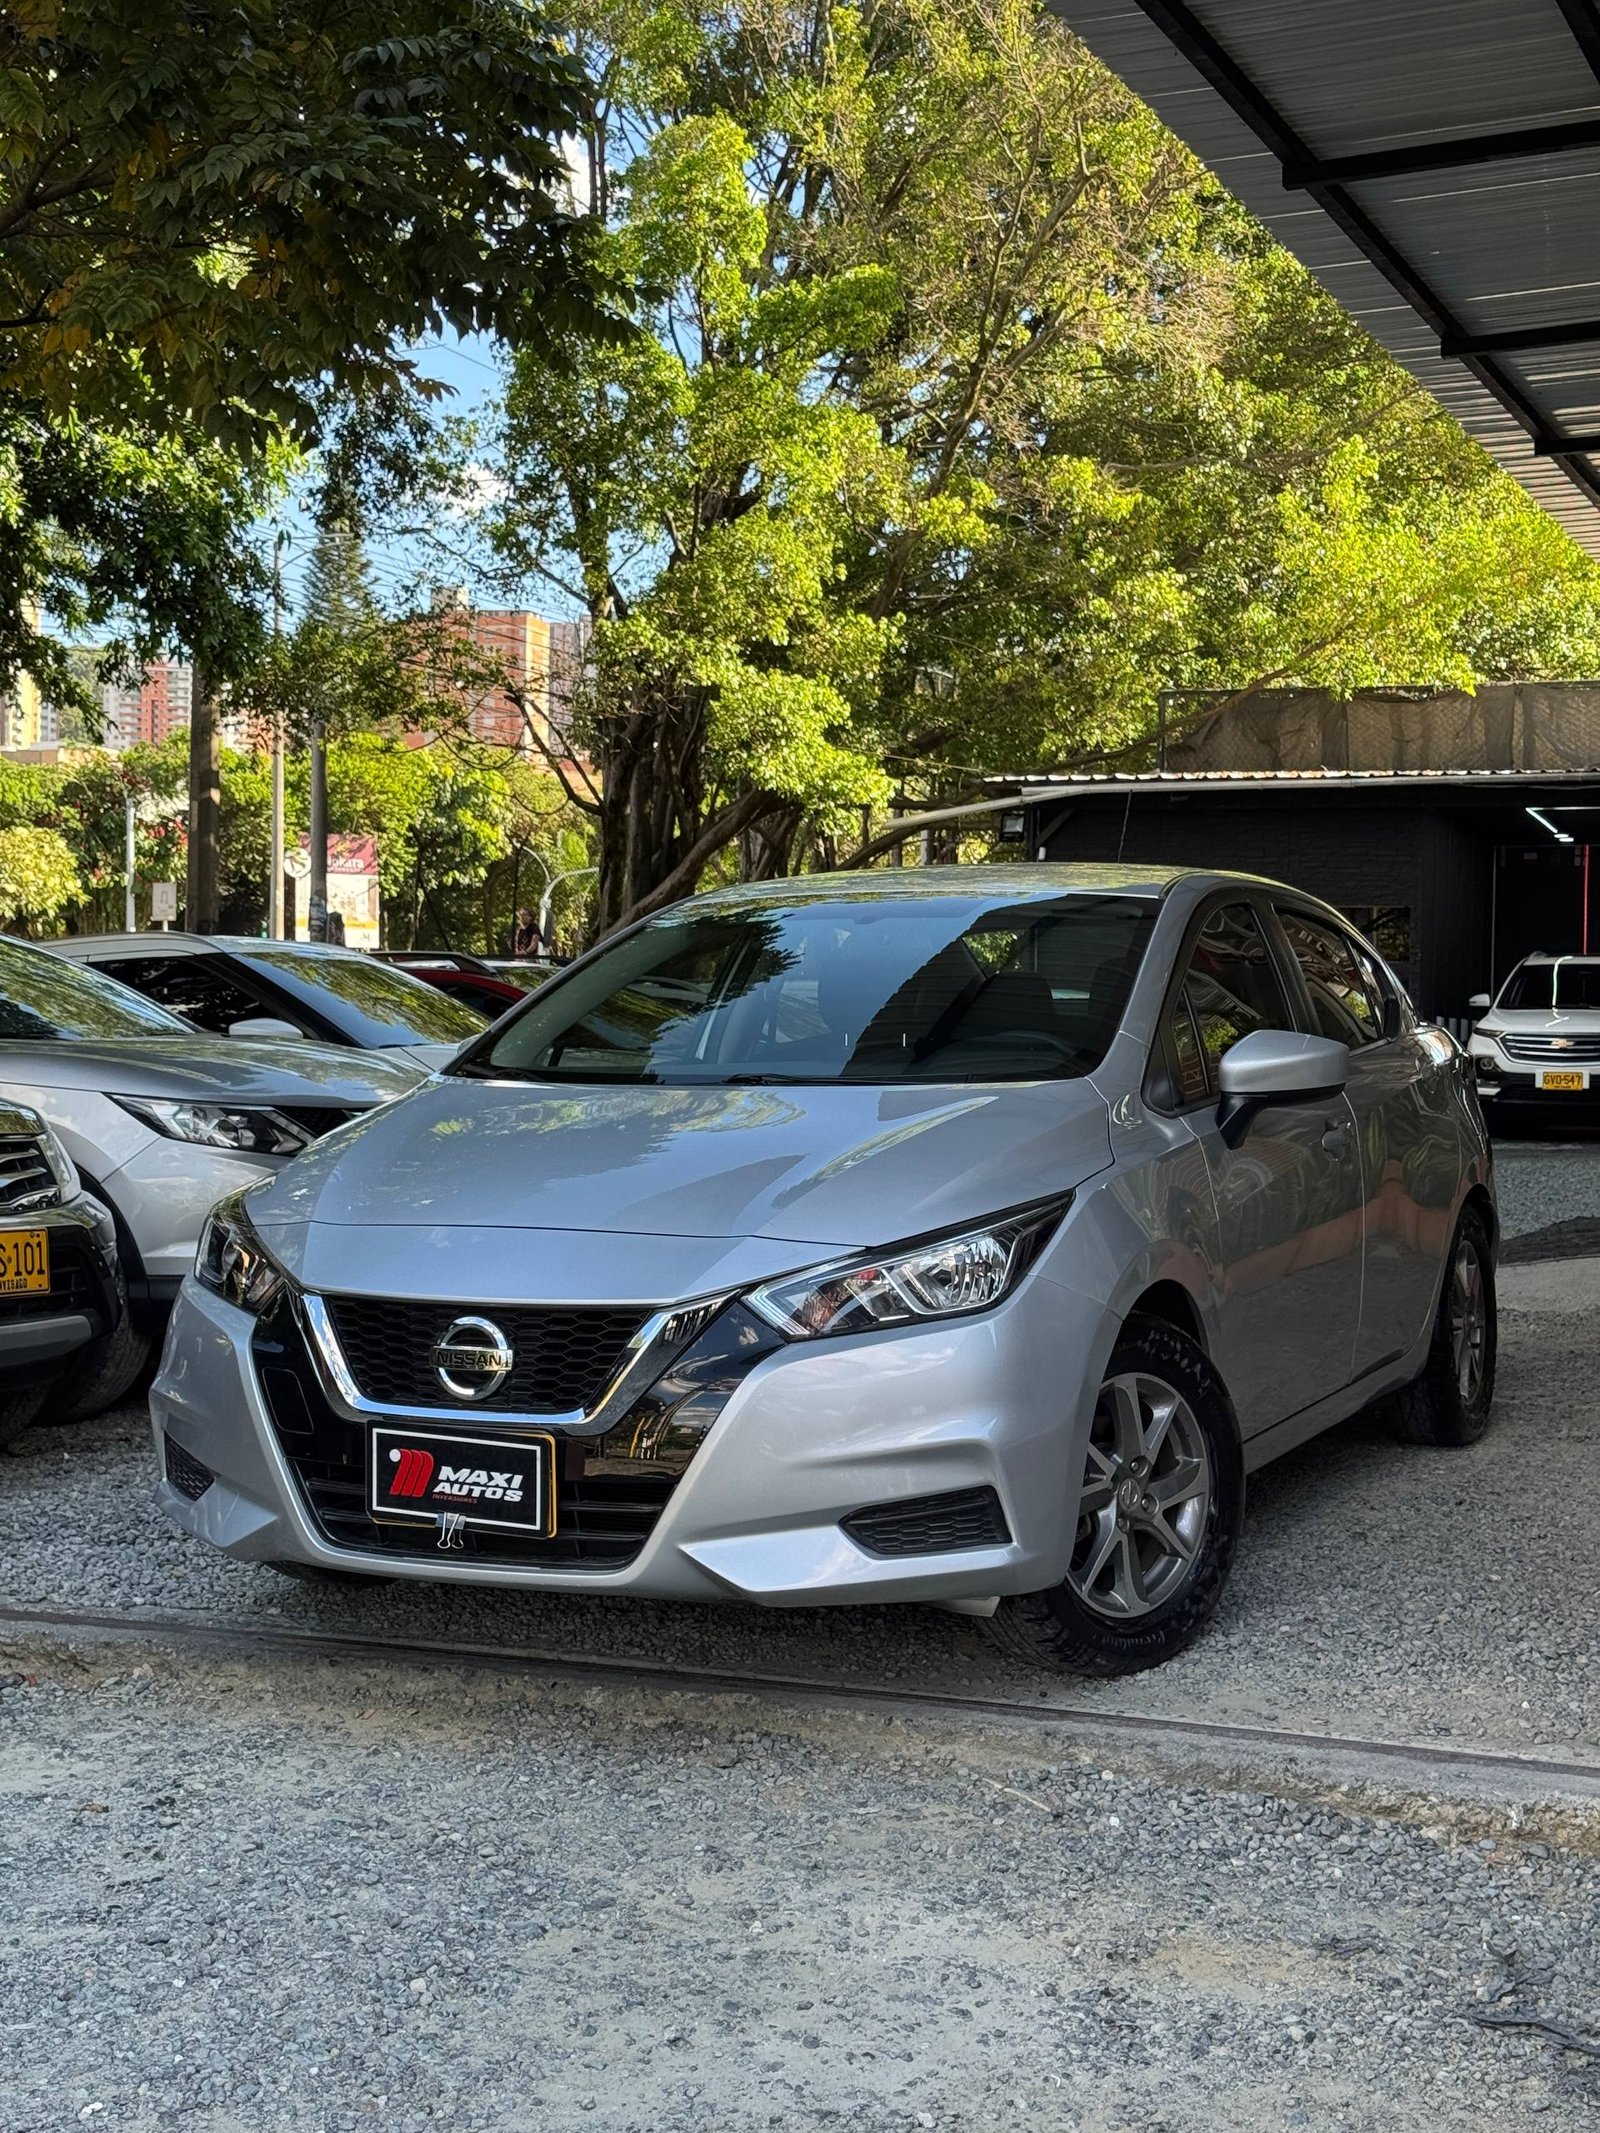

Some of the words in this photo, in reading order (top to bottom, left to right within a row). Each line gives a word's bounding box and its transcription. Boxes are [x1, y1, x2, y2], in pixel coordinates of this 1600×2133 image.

[436, 1351, 503, 1367] NISSAN
[437, 1465, 524, 1489] MAXI
[431, 1493, 478, 1504] INVERSIONES
[432, 1482, 524, 1502] AUTOS
